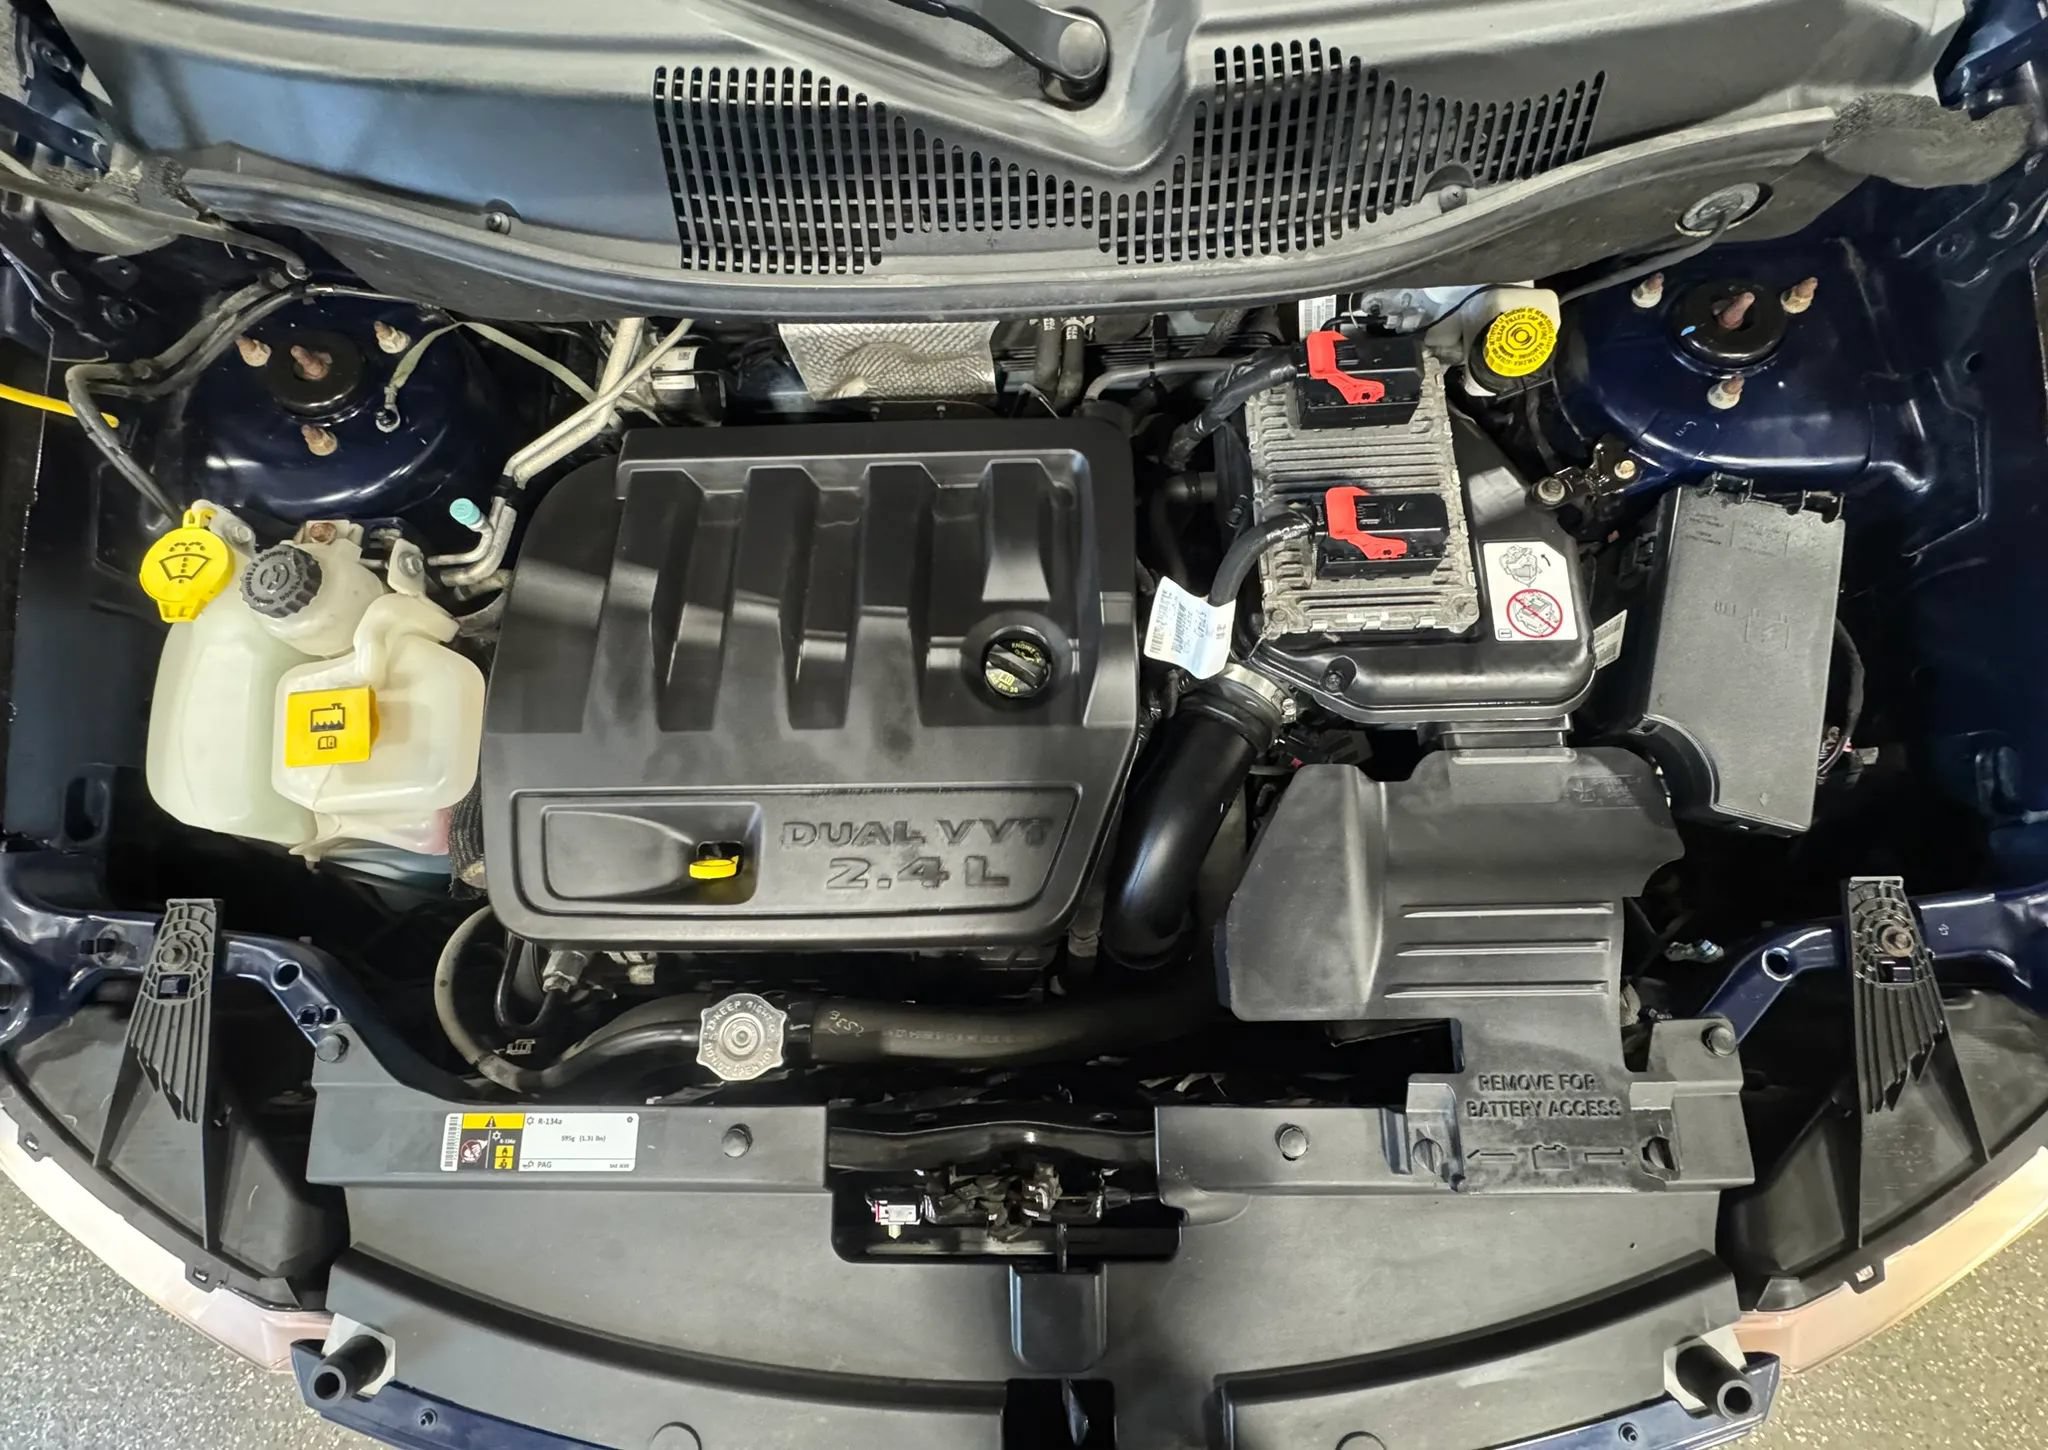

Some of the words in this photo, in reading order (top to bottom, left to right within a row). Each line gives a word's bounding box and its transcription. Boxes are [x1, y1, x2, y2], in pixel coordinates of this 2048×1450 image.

[1011, 642, 1036, 654] ENGINE
[782, 820, 926, 847] DUAL
[936, 818, 1054, 846] VVT
[713, 1000, 741, 1020] KEEP
[1478, 1073, 1555, 1092] REMOVE
[1558, 1073, 1596, 1092] FOR
[1466, 1100, 1542, 1118] BATTERY
[1548, 1099, 1623, 1118] ACCESS
[538, 1117, 563, 1126] R-134a
[537, 1161, 552, 1169] PAG
